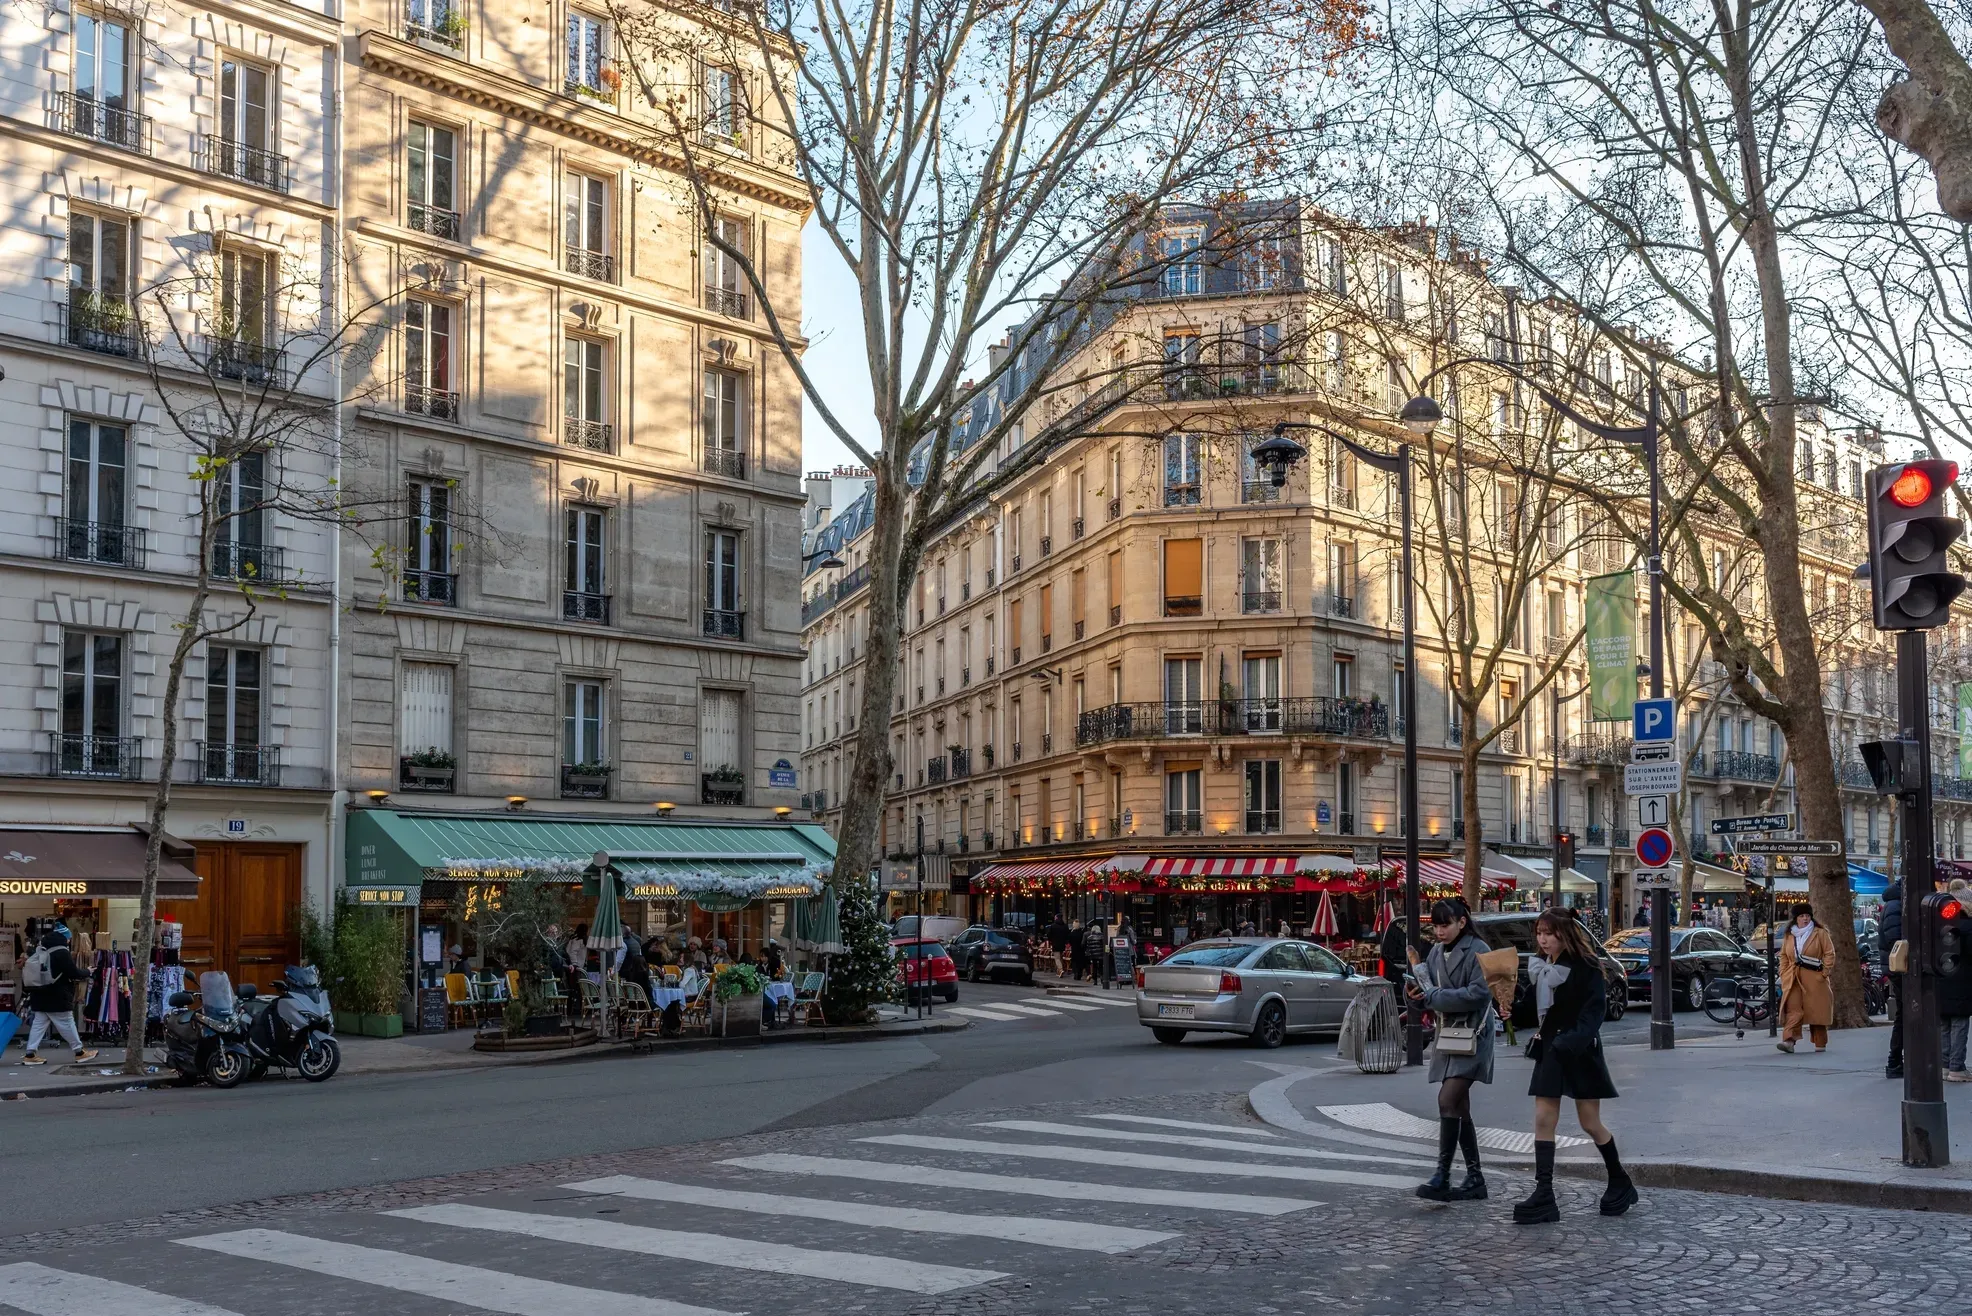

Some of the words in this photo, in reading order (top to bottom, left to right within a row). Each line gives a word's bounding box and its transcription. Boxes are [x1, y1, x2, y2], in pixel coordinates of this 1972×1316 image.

[1591, 636, 1632, 645] L'ACCORD
[1605, 643, 1630, 652] PARIS
[1620, 651, 1629, 659] LE
[1597, 660, 1627, 668] CLIMAT
[1644, 708, 1663, 734] P
[1628, 766, 1677, 775] STATIONNEMENT
[232, 821, 242, 831] 19
[361, 845, 376, 855] DINER
[1778, 844, 1798, 852] Champ
[361, 858, 376, 868] LUNCH
[361, 869, 386, 880] BREAKFAST
[0, 881, 87, 894] SOUVENIRS
[360, 890, 377, 901] SERVICE
[380, 890, 390, 901] NON
[391, 890, 404, 902] STOP
[1164, 1006, 1180, 1014] 2833
[1181, 1007, 1194, 1015] FTG
